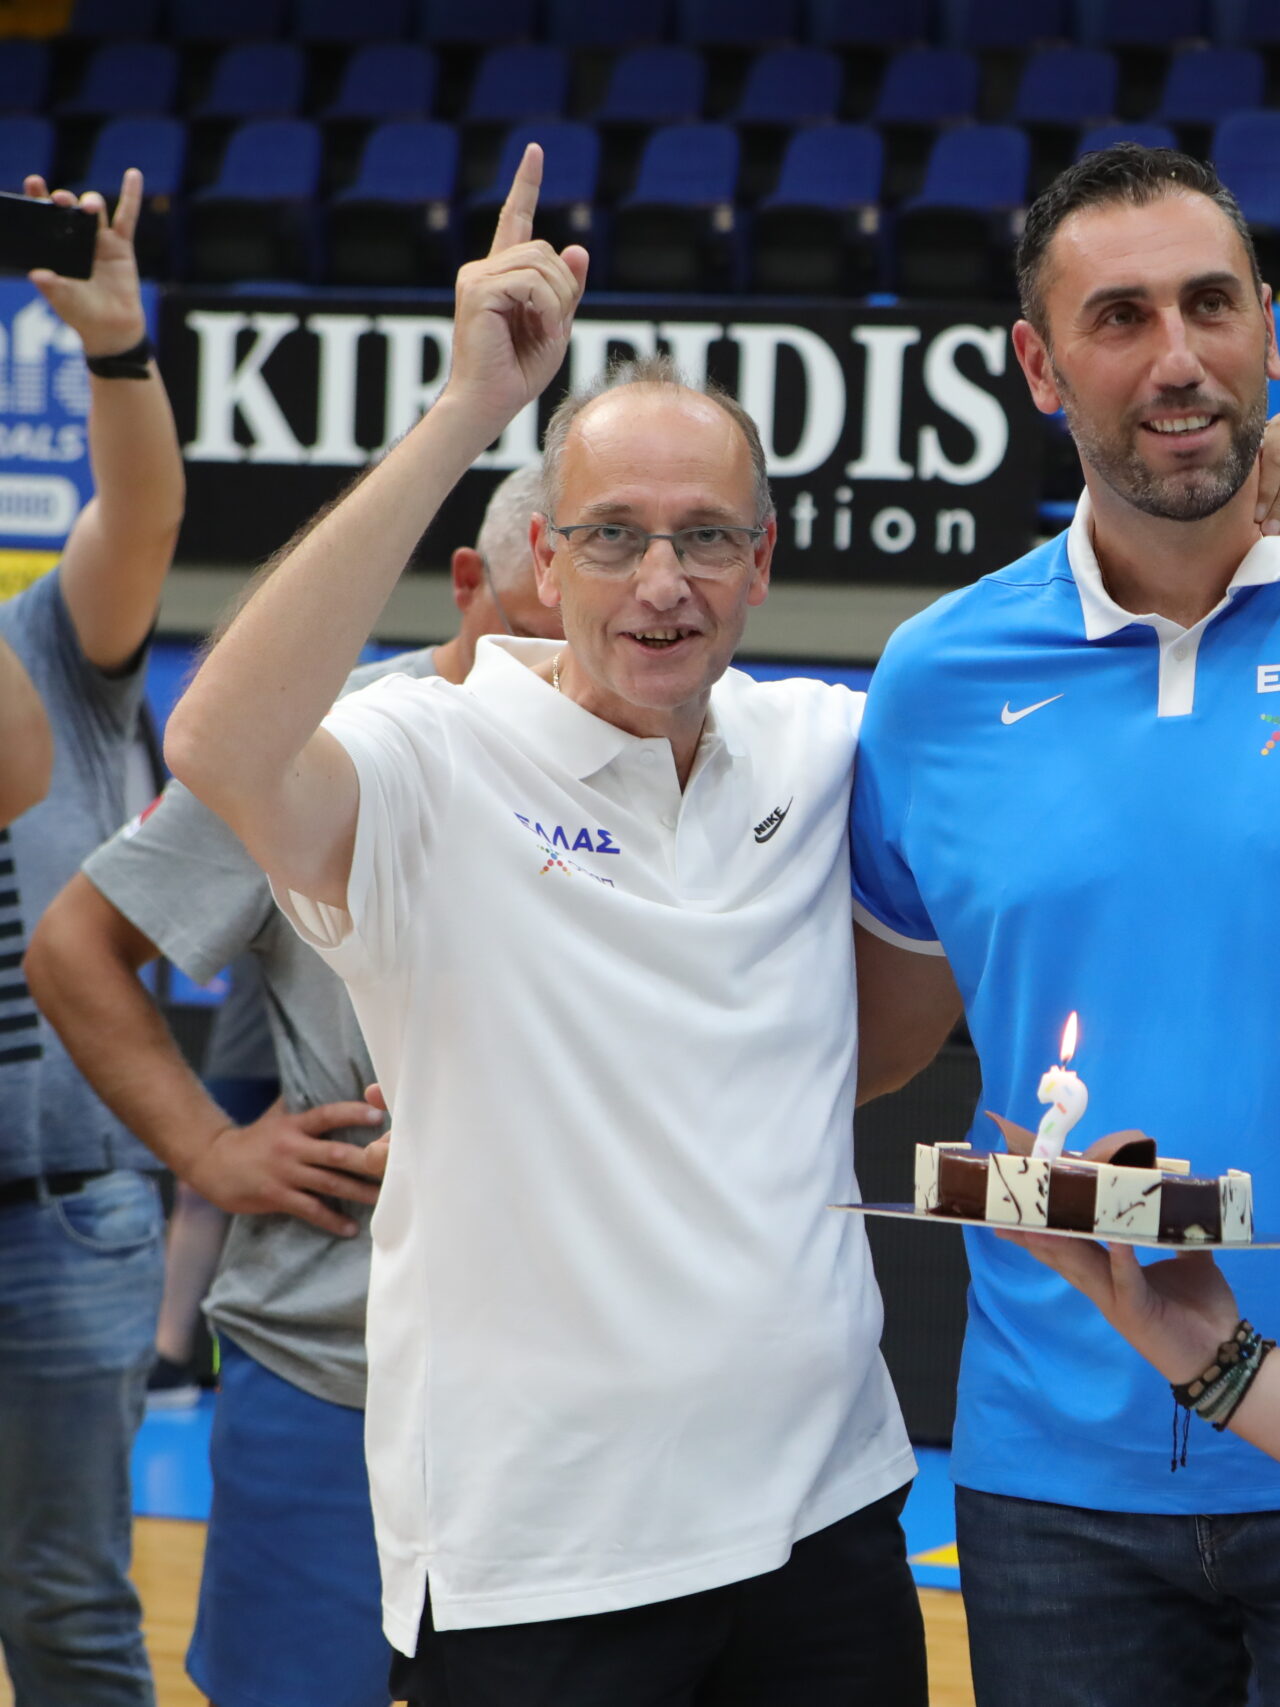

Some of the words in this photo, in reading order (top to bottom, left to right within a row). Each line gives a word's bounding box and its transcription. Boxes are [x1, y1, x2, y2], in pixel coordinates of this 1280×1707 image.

[185, 309, 1010, 486] KIRDIS
[789, 486, 976, 554] tion
[753, 806, 784, 836] NIKE
